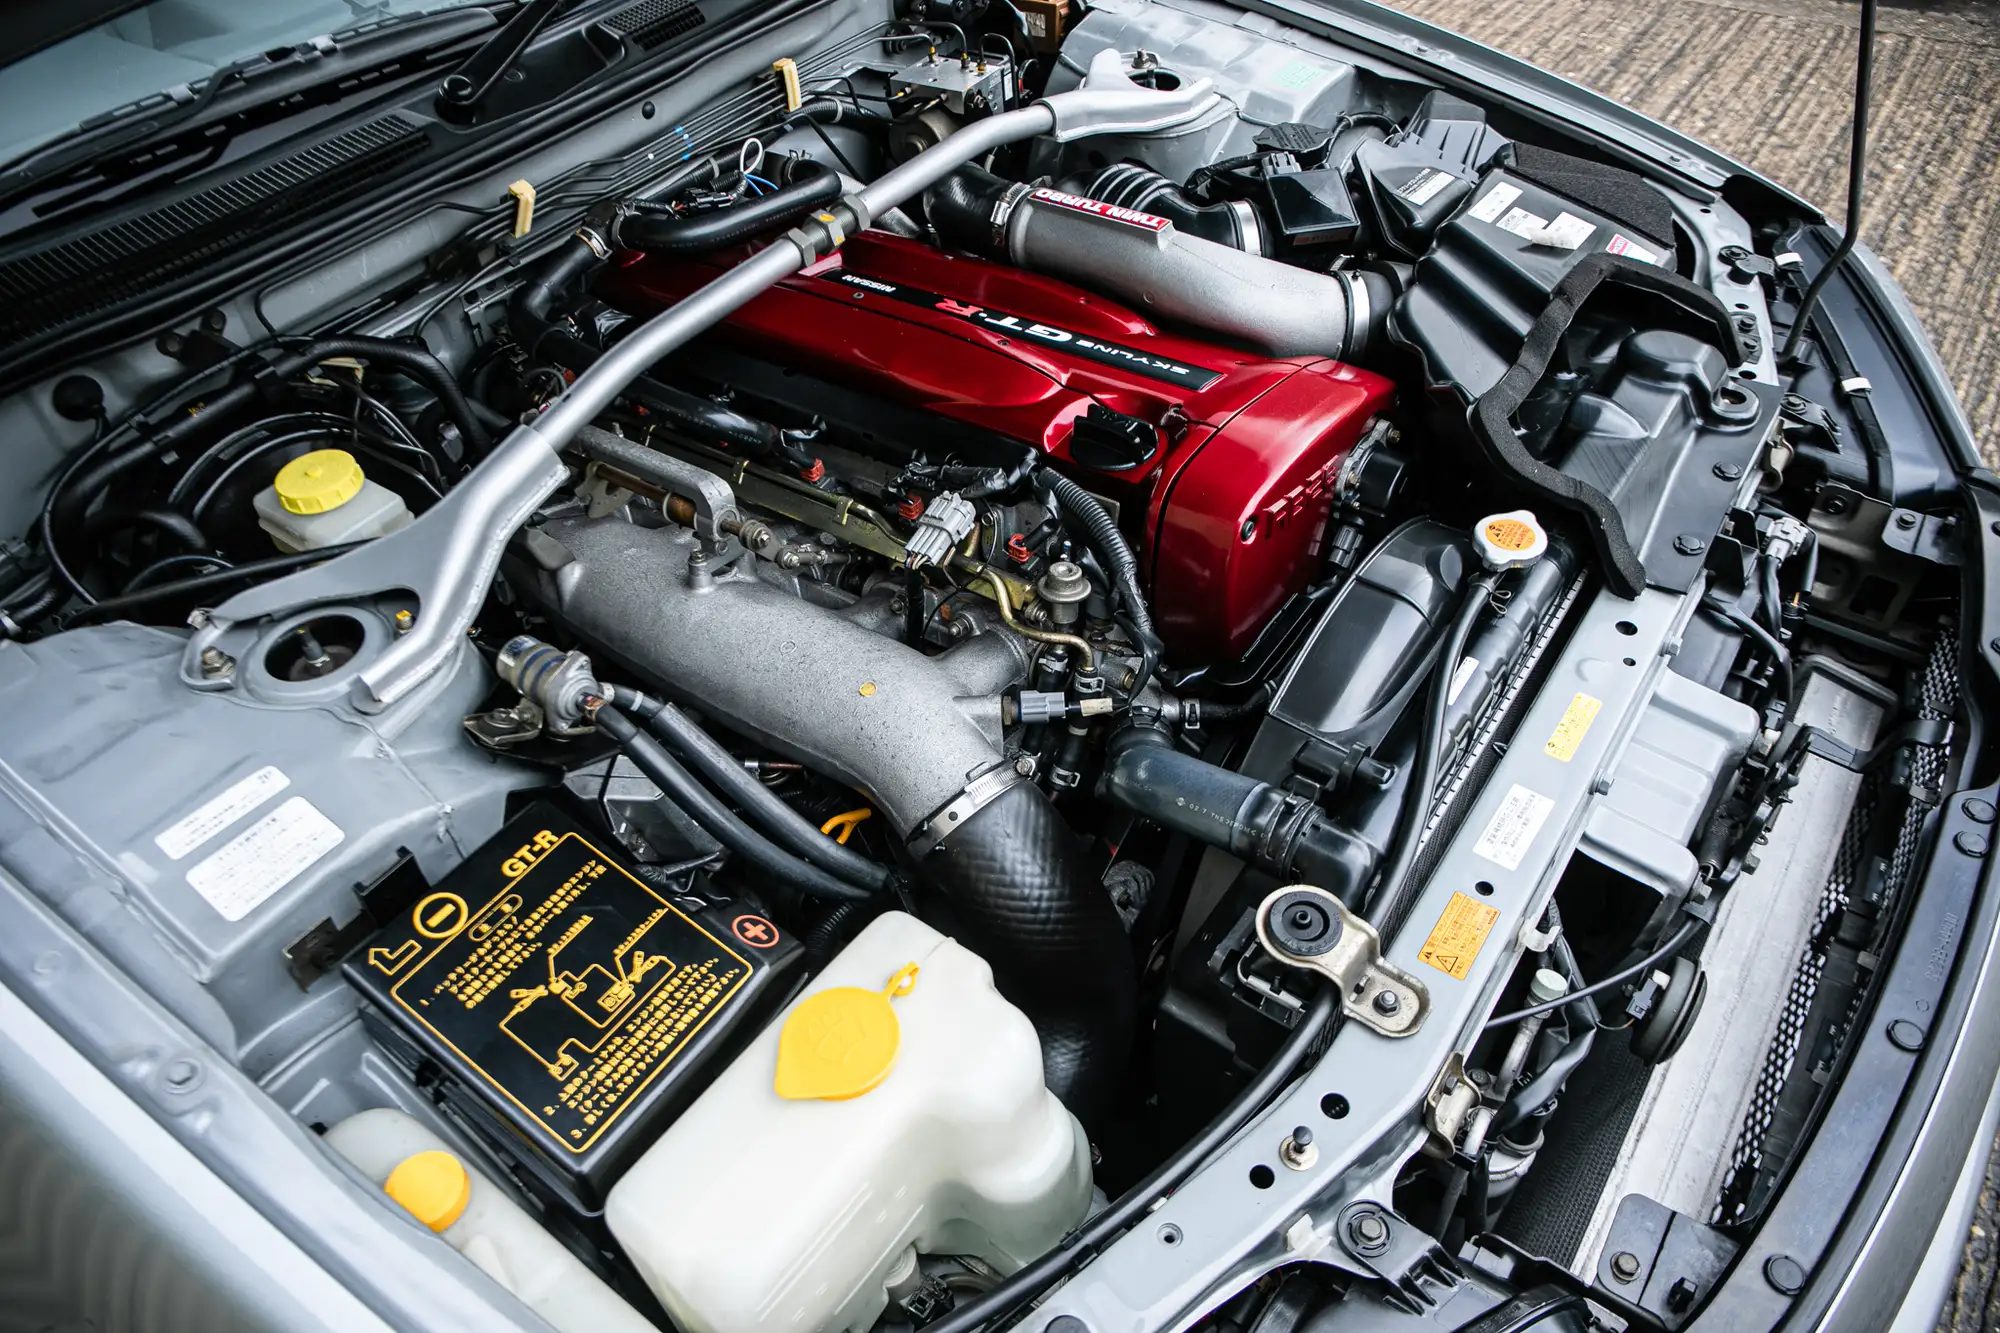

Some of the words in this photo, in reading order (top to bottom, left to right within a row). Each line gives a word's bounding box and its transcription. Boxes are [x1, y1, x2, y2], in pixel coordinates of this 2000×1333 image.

[1034, 188, 1103, 213] TURBO
[1104, 206, 1162, 228] TWIN
[841, 274, 896, 293] NISSAN
[1076, 339, 1190, 376] SKYLINE
[501, 828, 560, 878] GT-R
